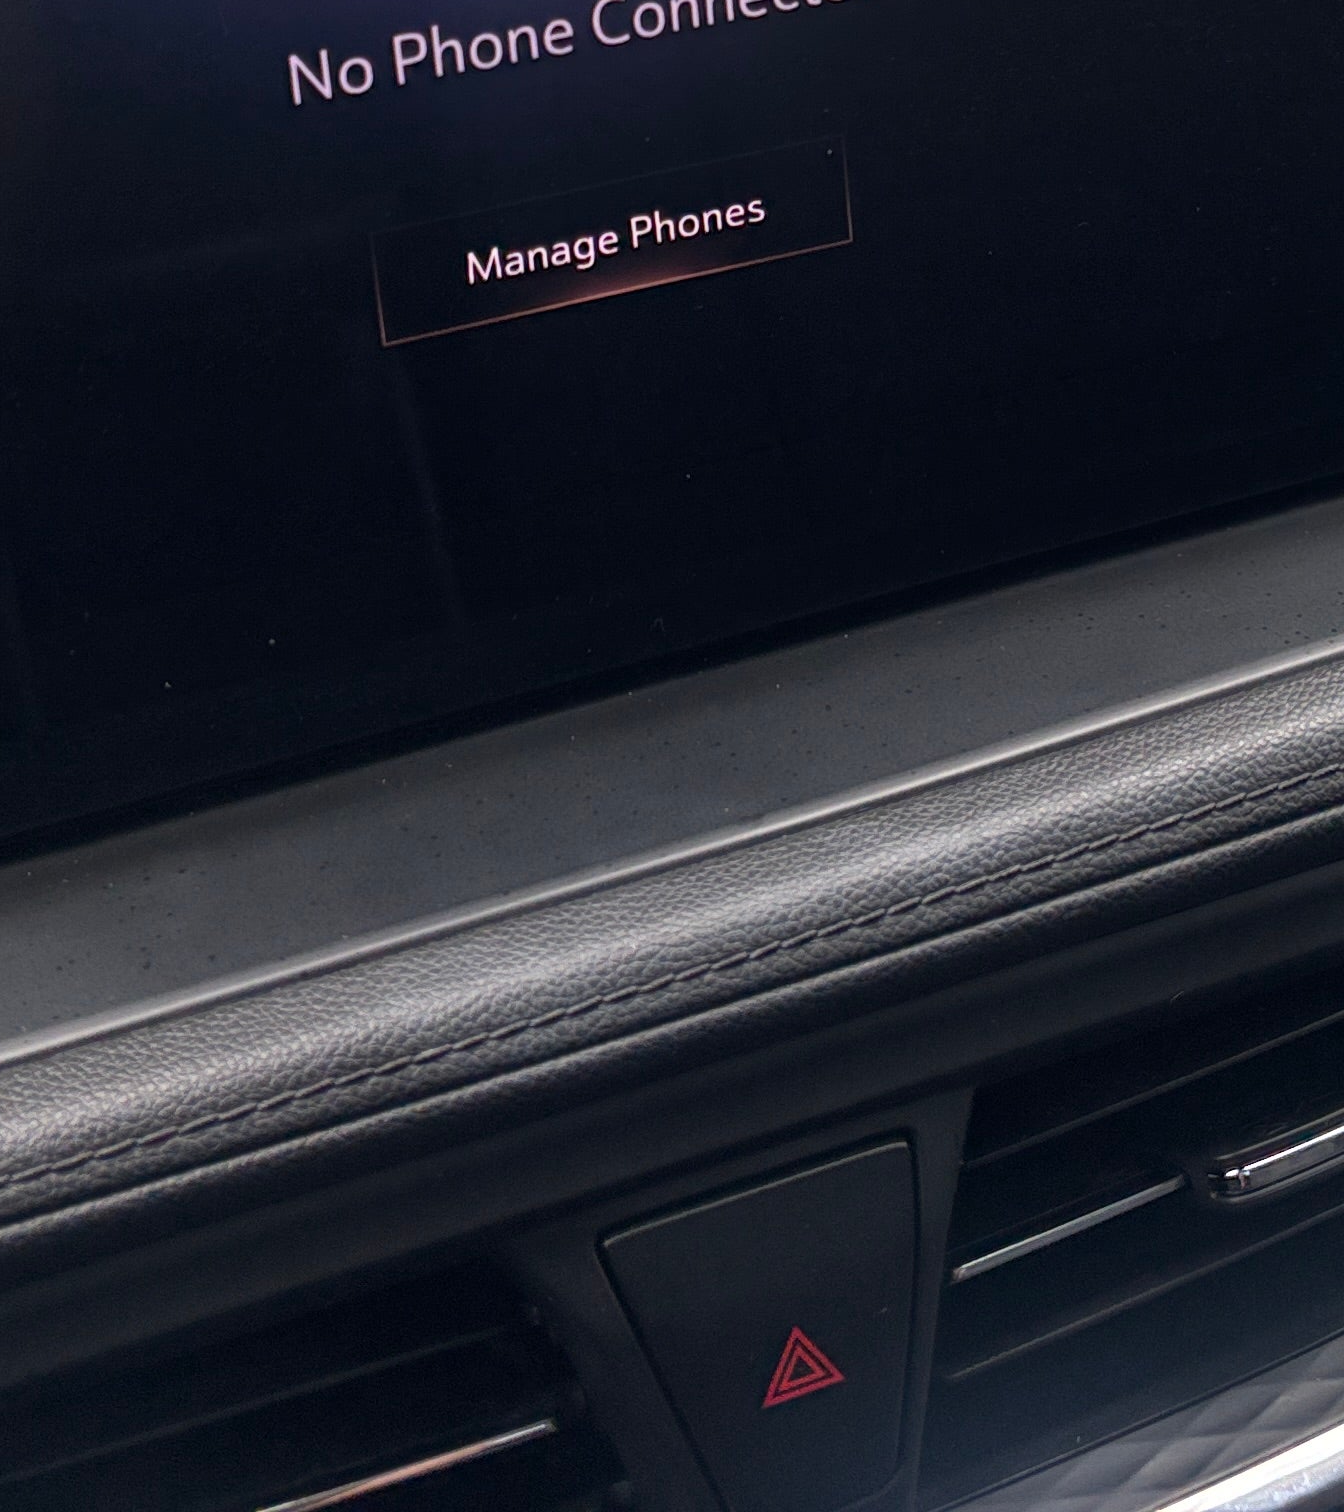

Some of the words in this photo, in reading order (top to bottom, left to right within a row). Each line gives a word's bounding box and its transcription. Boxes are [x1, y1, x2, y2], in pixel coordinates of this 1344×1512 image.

[287, 48, 375, 106] No
[391, 18, 575, 86] Phone
[466, 230, 620, 285] Manage
[629, 198, 767, 250] Phones
